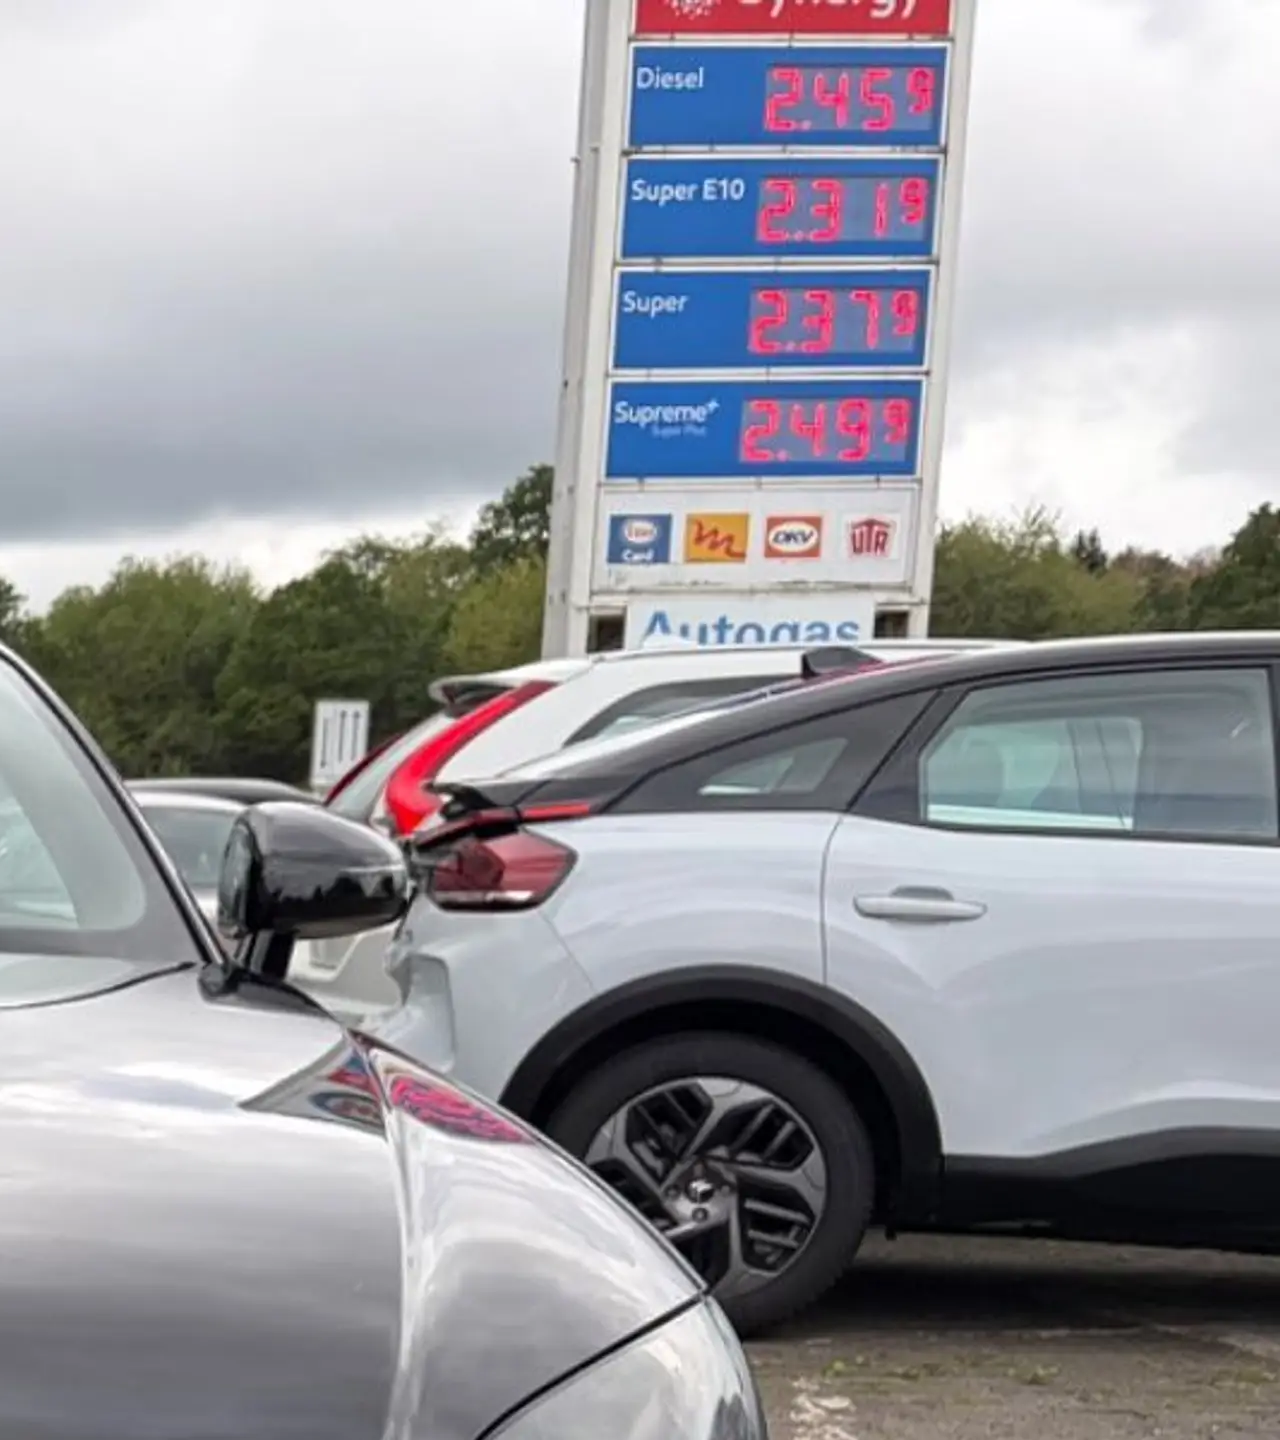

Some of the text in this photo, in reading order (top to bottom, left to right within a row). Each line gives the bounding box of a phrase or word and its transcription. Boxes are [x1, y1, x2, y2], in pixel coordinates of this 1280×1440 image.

[636, 65, 705, 90] Diesel
[631, 178, 746, 207] Super E10
[622, 290, 689, 318] Super
